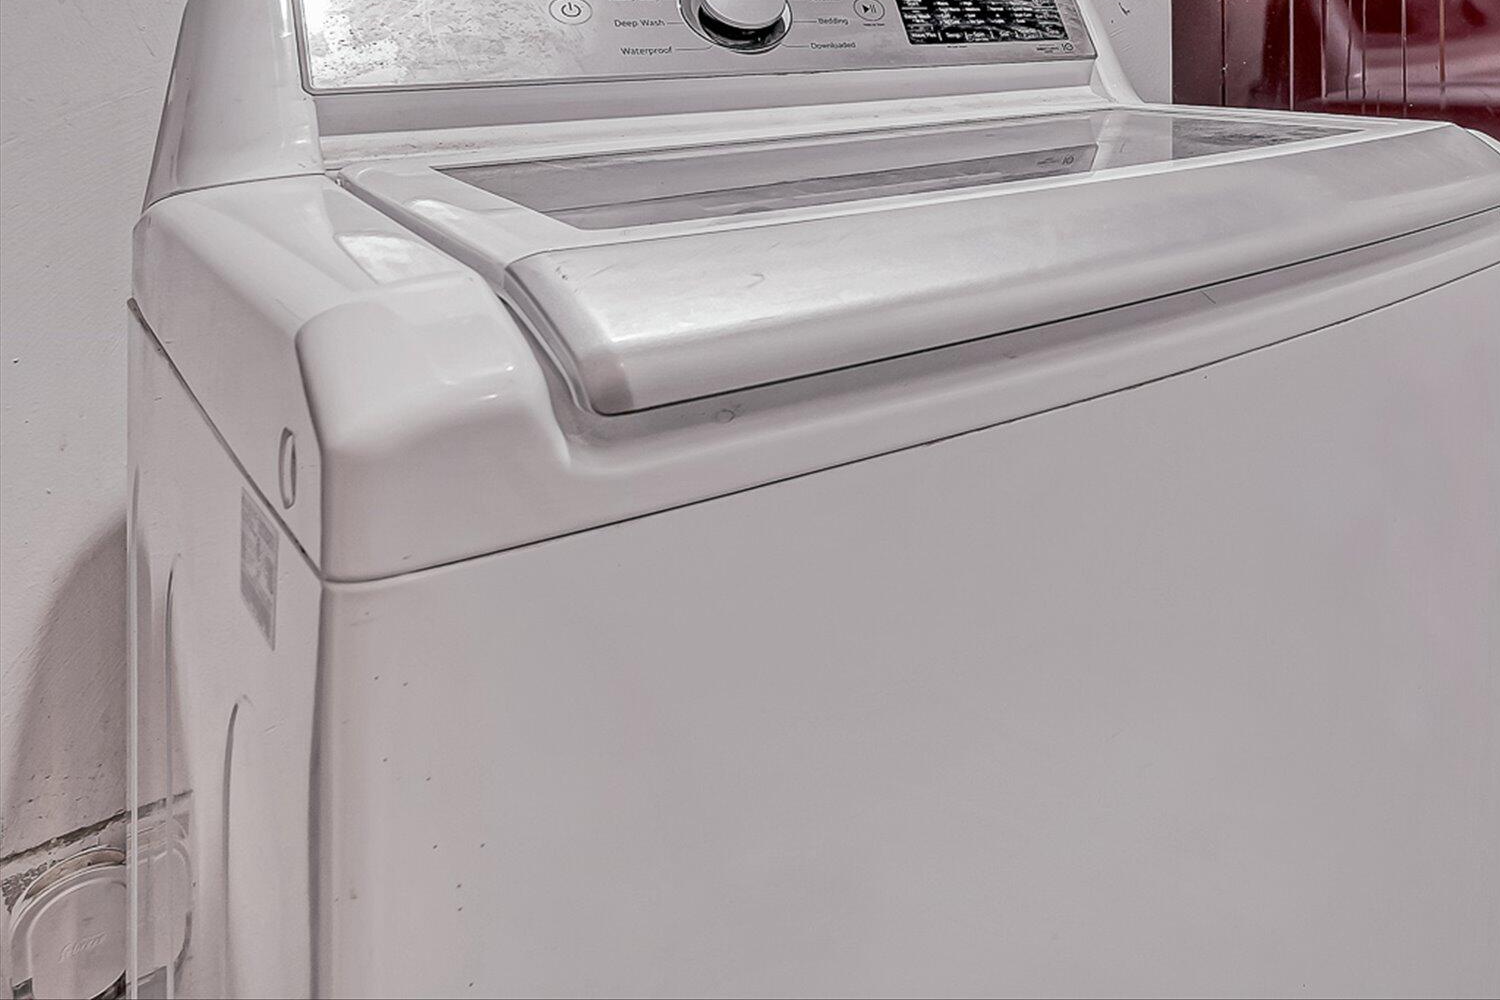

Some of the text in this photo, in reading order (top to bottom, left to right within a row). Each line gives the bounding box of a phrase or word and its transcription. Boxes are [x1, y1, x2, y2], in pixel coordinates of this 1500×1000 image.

[614, 19, 666, 28] Deep Wash
[810, 42, 856, 50] Downloaded
[620, 46, 673, 56] Waterproof
